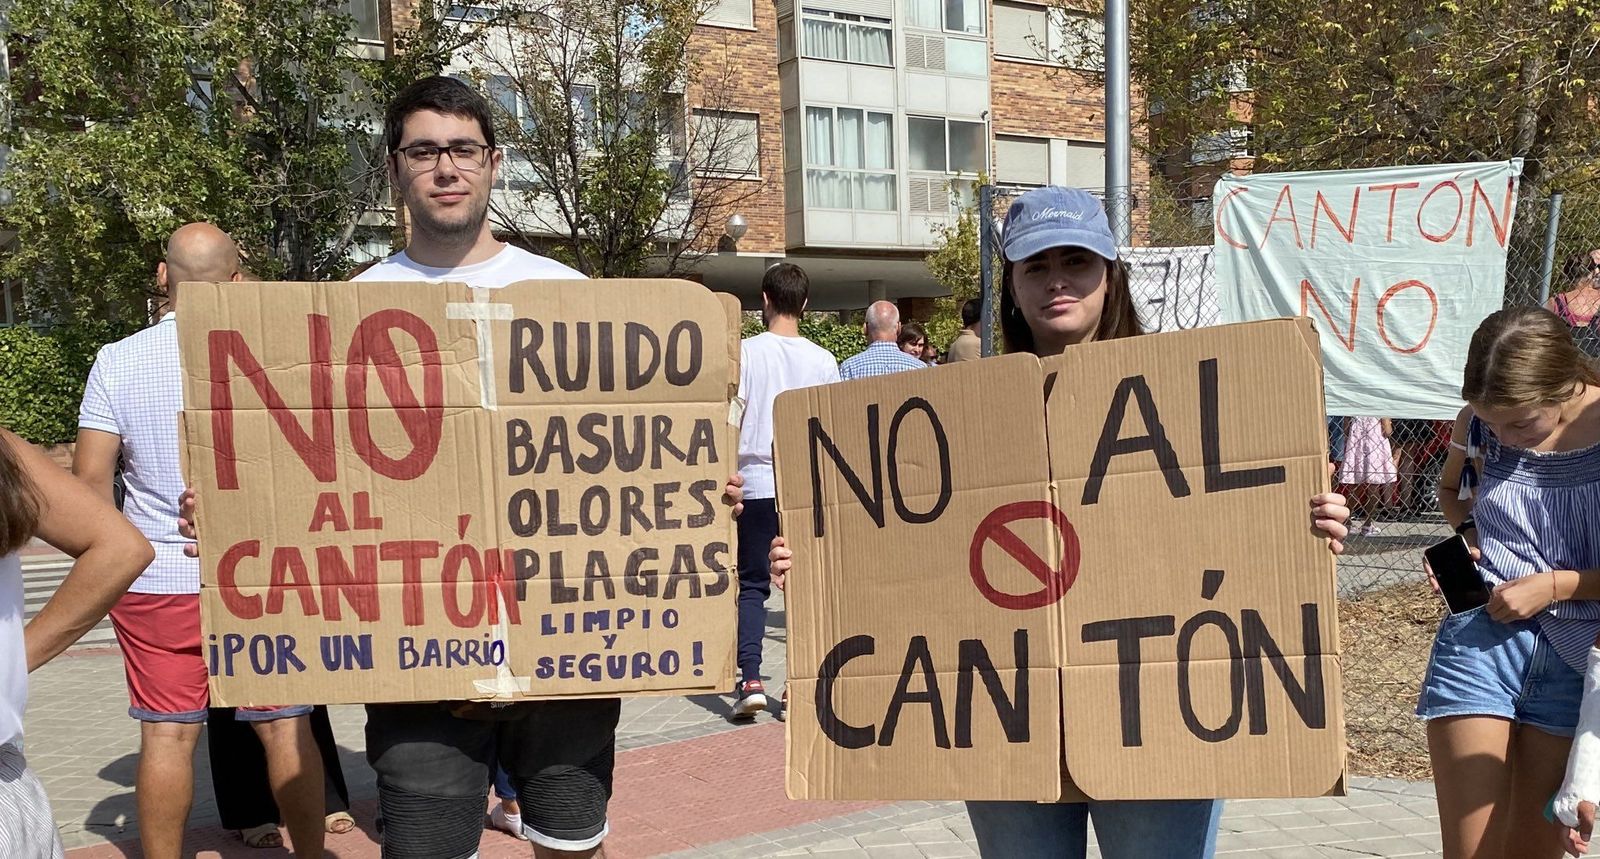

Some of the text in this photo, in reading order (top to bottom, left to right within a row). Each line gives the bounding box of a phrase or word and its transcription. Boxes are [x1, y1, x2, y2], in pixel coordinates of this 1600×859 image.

[1032, 207, 1083, 220] Mermaid
[1300, 277, 1438, 354] NO
[510, 319, 702, 393] RUIDO
[208, 308, 443, 489] NO
[507, 413, 718, 475] BASURA
[808, 358, 1286, 537] NO AL
[309, 492, 382, 532] AL
[509, 480, 717, 537] OLORES
[217, 515, 521, 627] CANTÓN
[515, 542, 730, 604] PLAGAS
[541, 608, 679, 635] LIMPIO
[209, 633, 306, 676] ¡POR
[320, 633, 373, 670] UN
